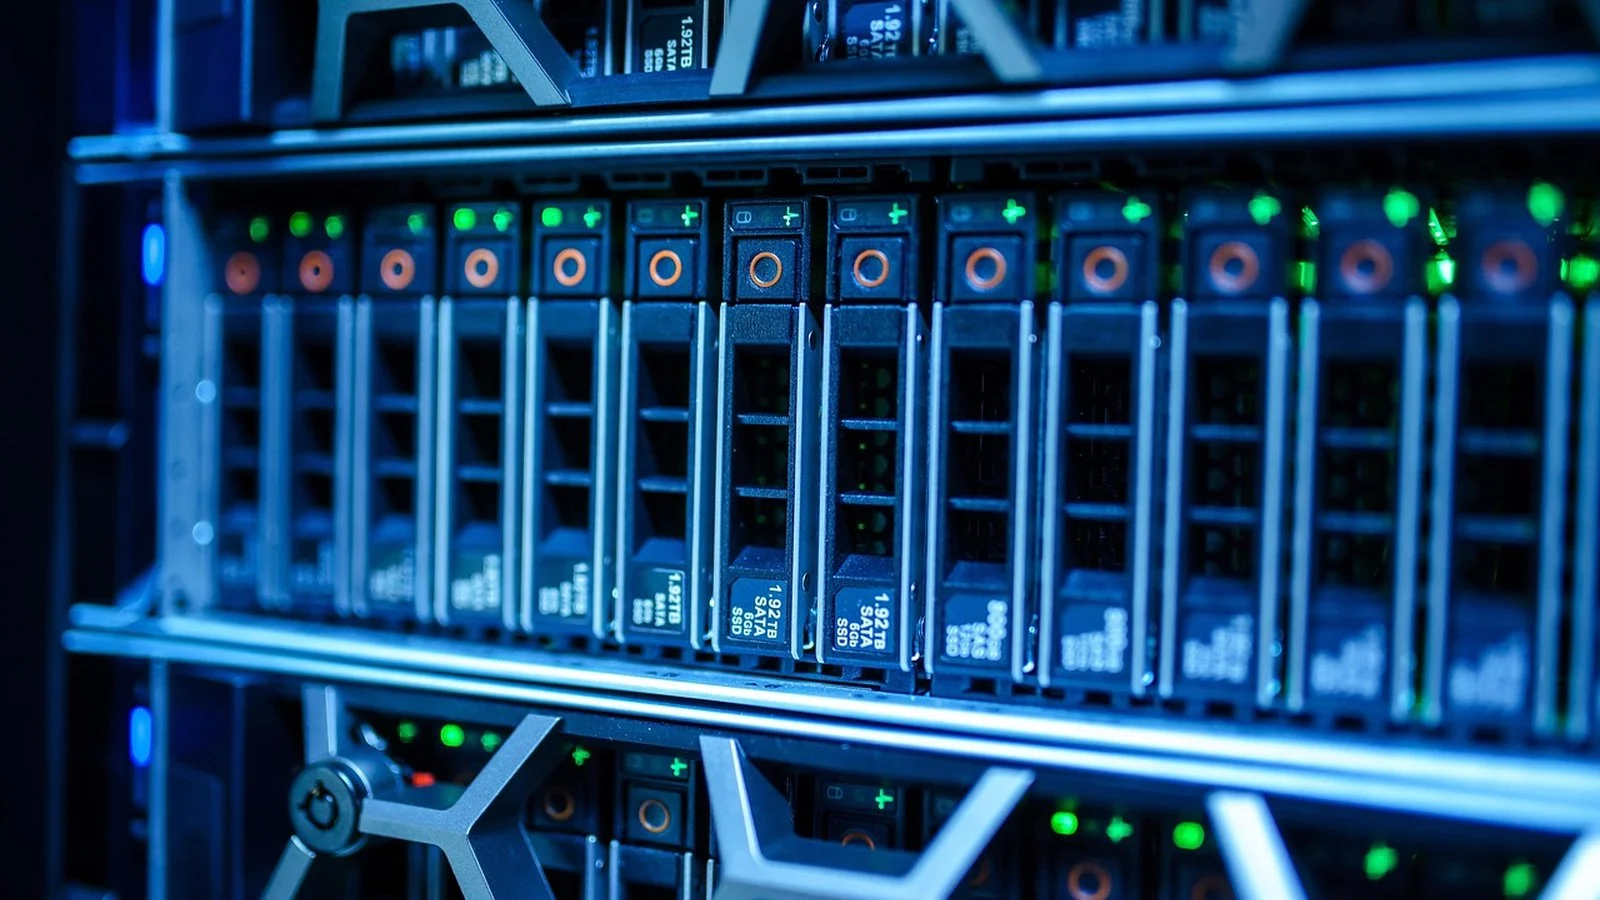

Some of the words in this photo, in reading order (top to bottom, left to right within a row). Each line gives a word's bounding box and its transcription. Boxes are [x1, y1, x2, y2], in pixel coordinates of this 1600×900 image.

[681, 16, 693, 68] 1.92TB
[885, 4, 901, 57] 1.92T
[667, 40, 677, 71] SATA
[668, 573, 681, 625] 1.92TB
[754, 596, 767, 637] SATA
[732, 607, 743, 635] SSD
[743, 612, 754, 636] 6Gb
[837, 617, 848, 647] SSD
[849, 622, 860, 648] 6Gb
[860, 605, 873, 648] SATA
